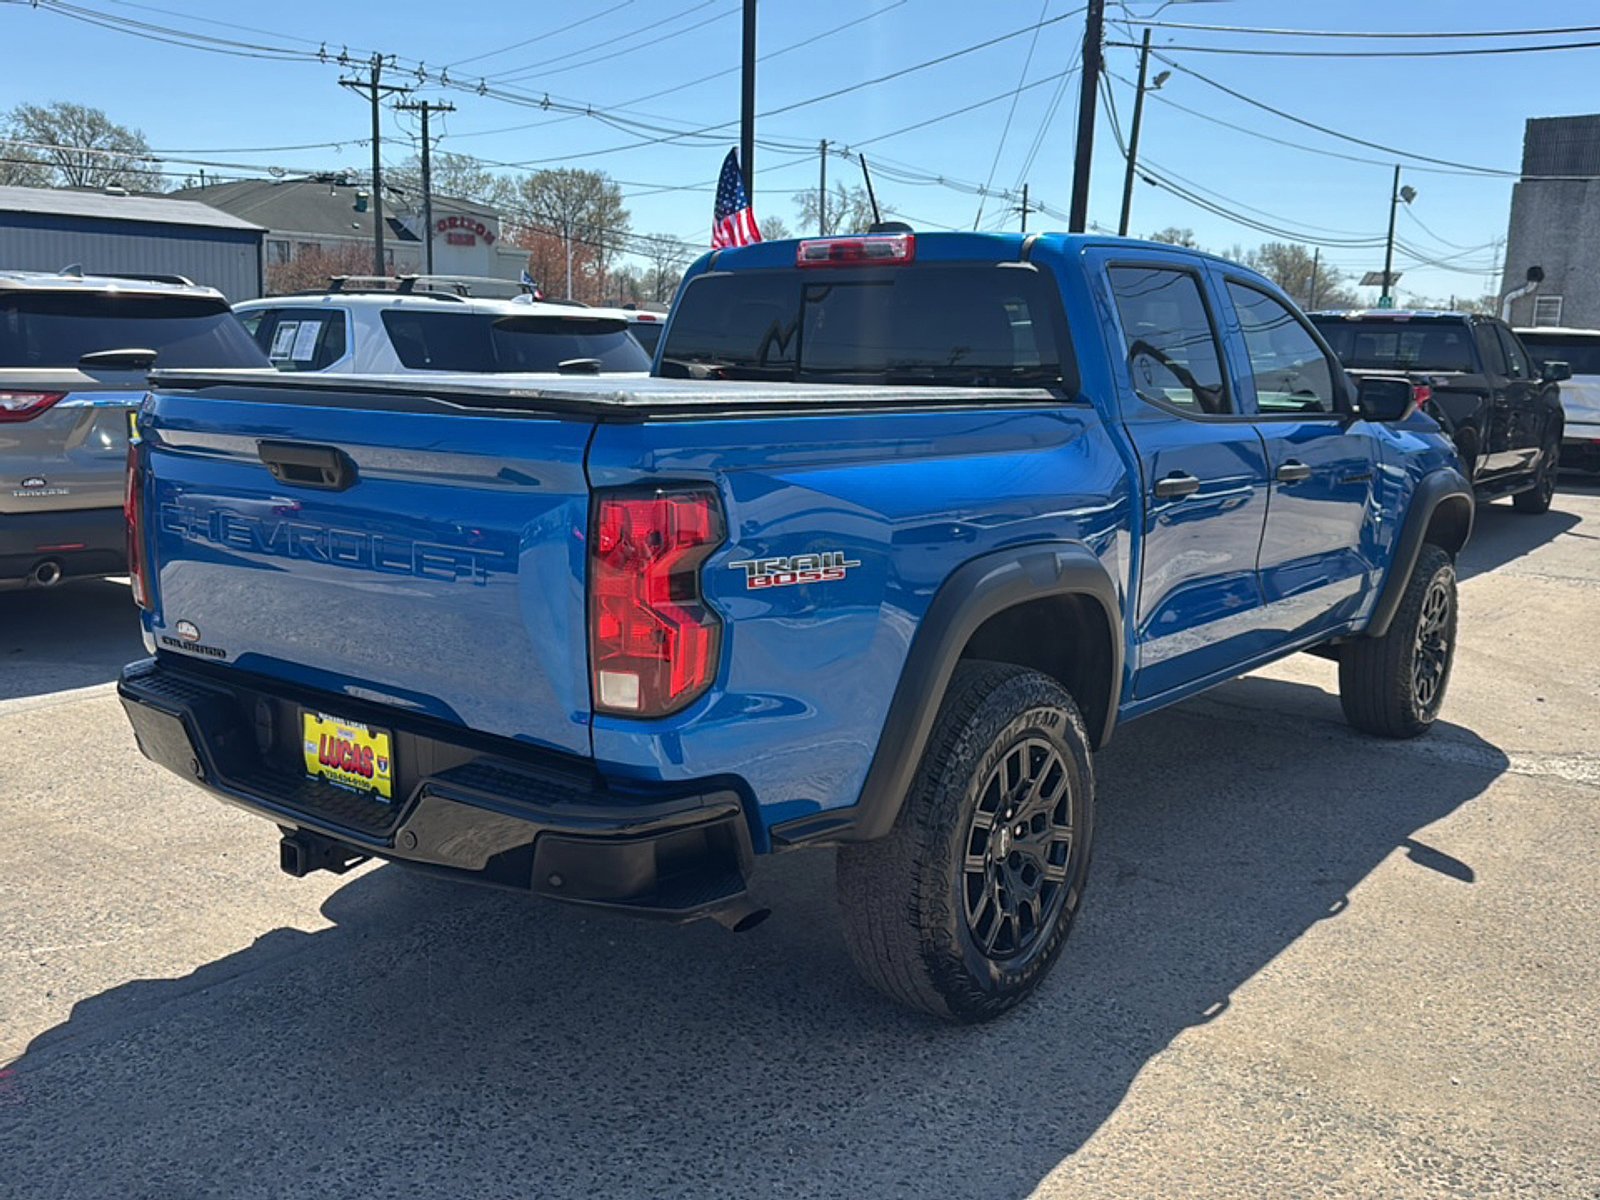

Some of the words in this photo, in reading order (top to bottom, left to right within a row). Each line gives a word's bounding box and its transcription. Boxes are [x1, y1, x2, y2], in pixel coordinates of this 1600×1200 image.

[160, 502, 504, 586] CHEVROLET
[728, 551, 861, 576] TRAIL
[747, 568, 846, 589] BOSS
[319, 733, 375, 779] LUCAS
